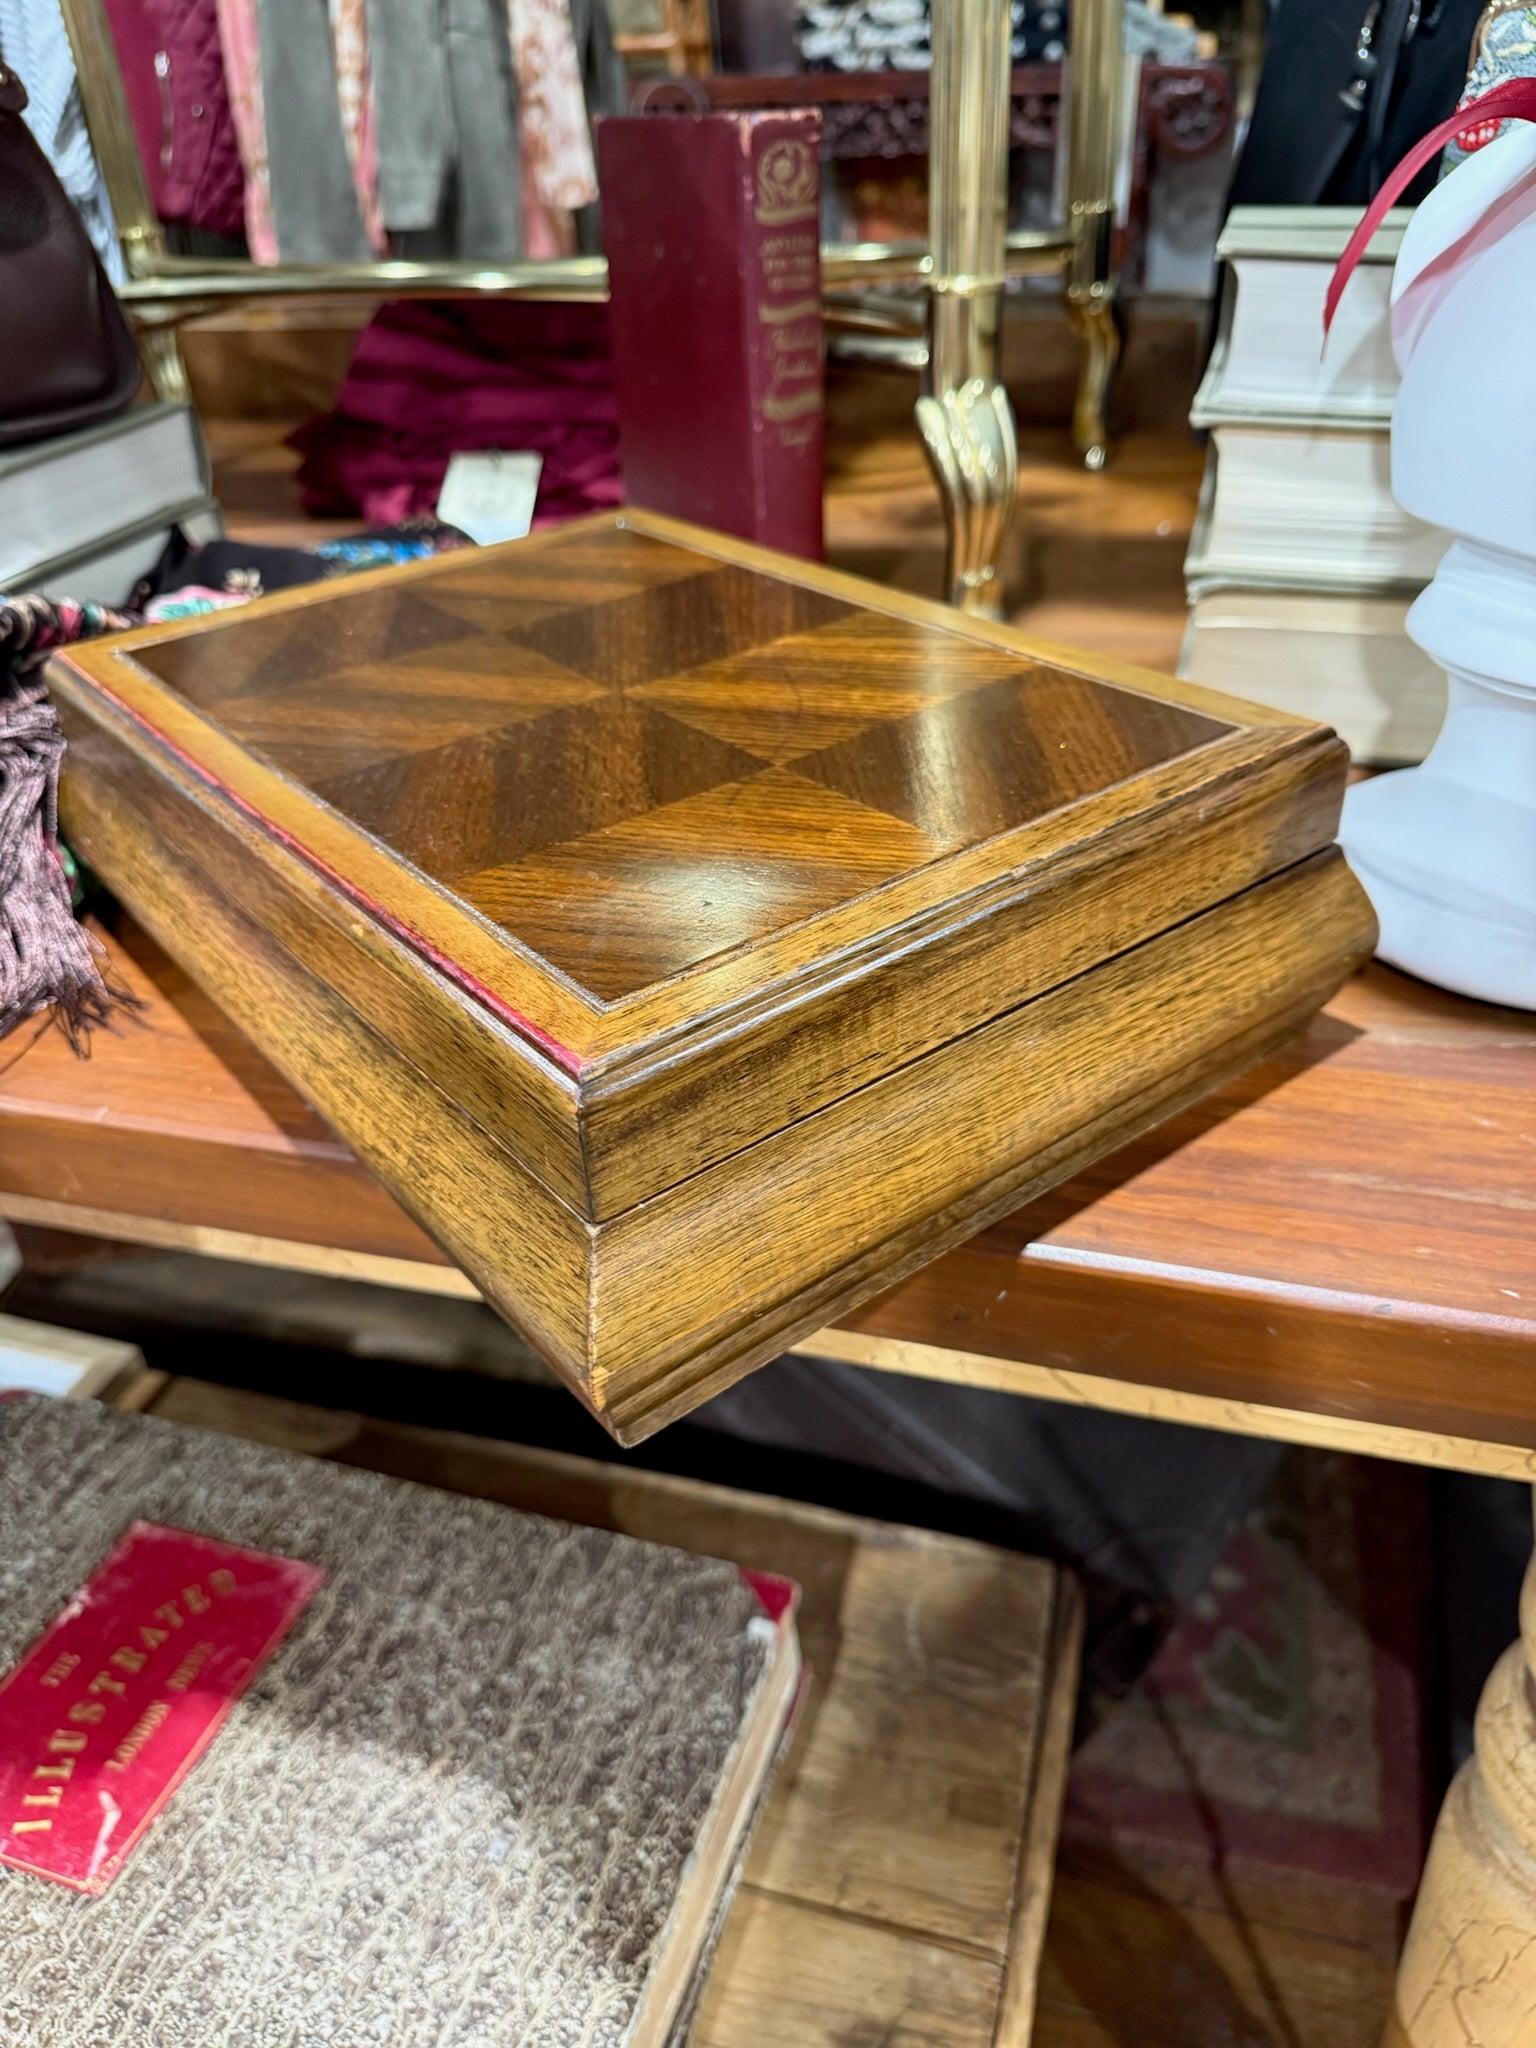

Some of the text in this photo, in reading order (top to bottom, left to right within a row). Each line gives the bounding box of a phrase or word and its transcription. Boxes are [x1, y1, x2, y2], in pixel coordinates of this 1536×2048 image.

[11, 1568, 237, 1835] ILLUSTRATED
[40, 1653, 81, 1687] THE
[105, 1642, 215, 1772] LONDON NEWS
